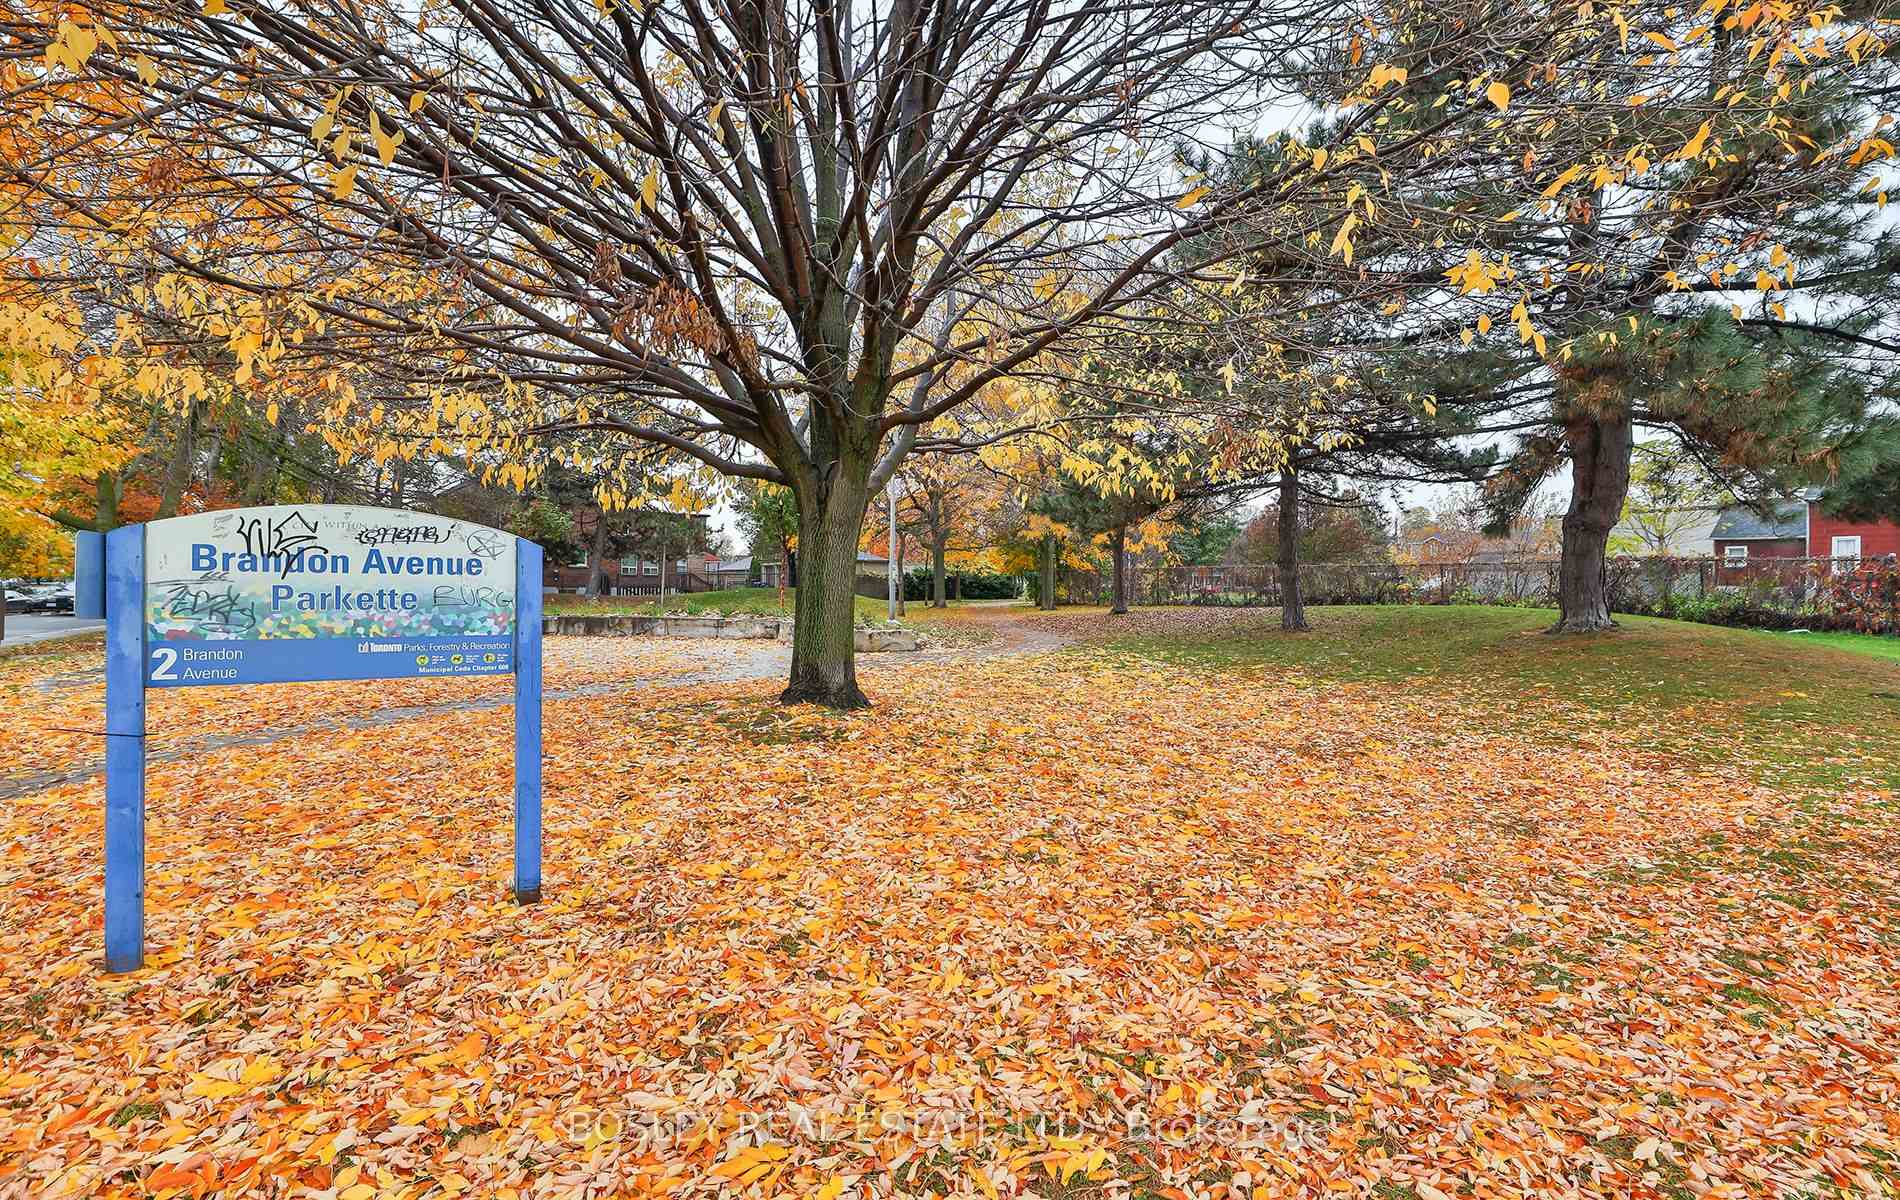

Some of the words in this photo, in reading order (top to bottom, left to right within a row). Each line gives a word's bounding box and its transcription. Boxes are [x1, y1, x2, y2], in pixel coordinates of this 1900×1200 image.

[191, 543, 350, 574] Brandon
[362, 548, 483, 575] Avenue
[272, 585, 418, 610] Parkette
[183, 647, 243, 661] Brandon
[429, 643, 461, 653] Forestry
[462, 642, 470, 650] &
[471, 641, 511, 650] Recreation
[151, 648, 178, 680] 2
[419, 665, 453, 674] Municipal
[472, 664, 497, 673] Chapter
[183, 667, 237, 680] Avenue
